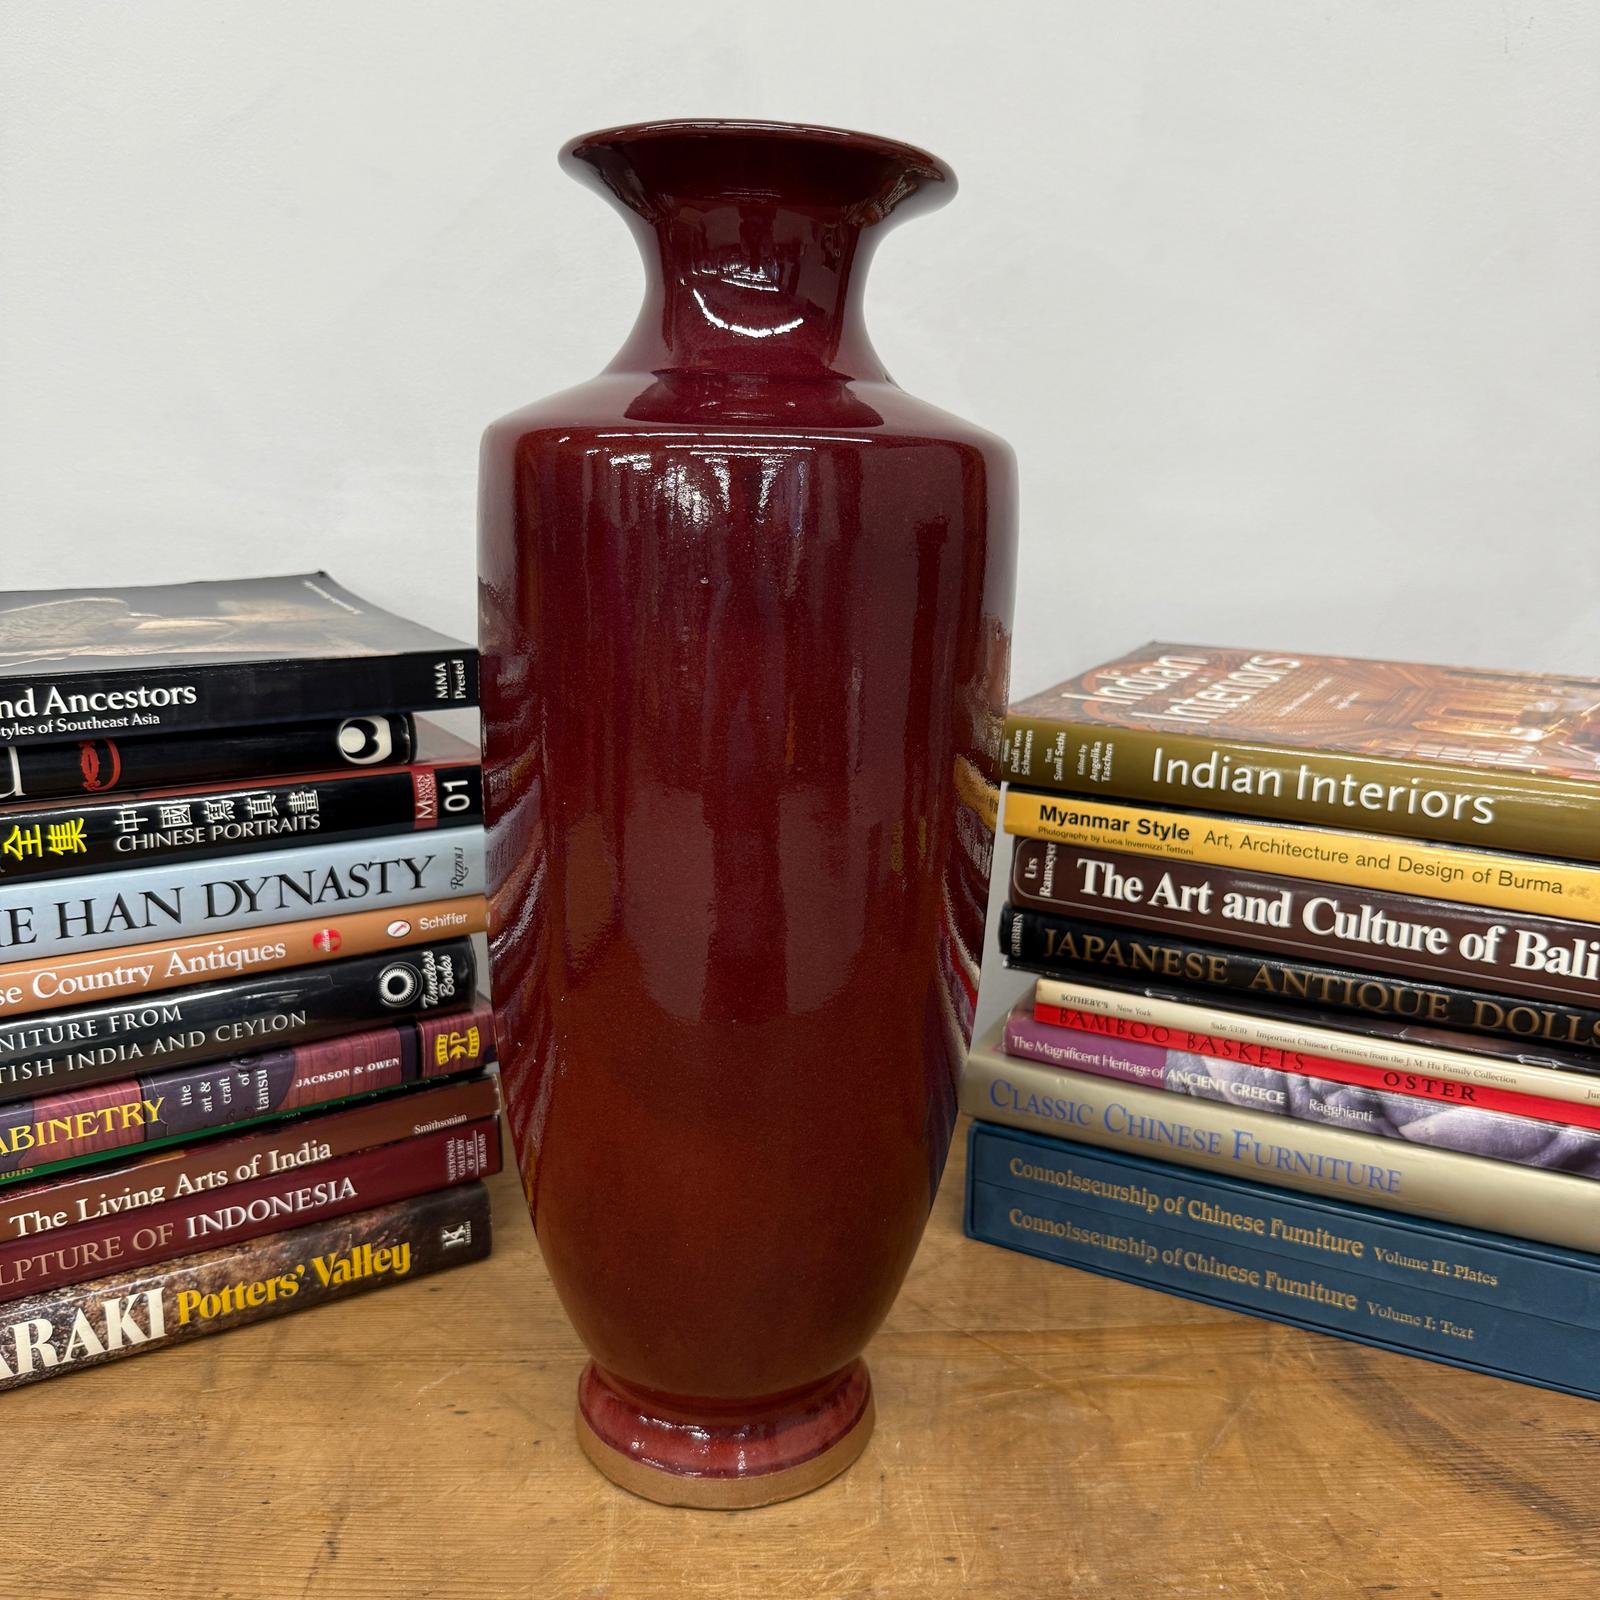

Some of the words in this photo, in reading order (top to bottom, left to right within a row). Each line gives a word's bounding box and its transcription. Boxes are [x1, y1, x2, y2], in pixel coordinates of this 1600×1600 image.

[434, 662, 448, 698] MMA
[452, 659, 466, 699] Prestel
[1061, 655, 1208, 705] Indian
[1131, 655, 1299, 724] Interiors
[0, 687, 38, 718] nd
[43, 686, 197, 715] Ancestors
[0, 722, 35, 740] tyles
[38, 719, 54, 734] of
[56, 716, 129, 732] Southeast
[132, 712, 160, 726] Asia
[1014, 729, 1022, 747] von
[1055, 732, 1066, 756] Sethi
[1011, 748, 1020, 773] Deidi
[1022, 729, 1033, 776] Schaewen
[1054, 757, 1063, 781] Sunil
[1089, 741, 1102, 782] Angelika
[1101, 743, 1114, 782] Taschen
[442, 780, 470, 812] 01
[1152, 747, 1280, 797] Indian
[1297, 764, 1496, 825] Interiors
[116, 826, 208, 852] CHINESE
[211, 814, 320, 841] PORTRAITS
[1038, 826, 1088, 841] Photography
[1090, 835, 1100, 843] by
[1102, 837, 1123, 846] Luca
[1125, 840, 1163, 851] Invernizzi
[1165, 844, 1194, 855] Tettoni
[1039, 805, 1130, 833] Myanmar
[1136, 818, 1190, 841] Style
[1204, 830, 1232, 850] Art,
[1239, 835, 1349, 864] Architecture
[1355, 854, 1390, 870] and
[1398, 856, 1464, 882] Design
[1472, 868, 1492, 884] of
[1498, 870, 1562, 894] Burma
[1024, 857, 1038, 879] Urs
[1039, 842, 1057, 897] Ramseyer
[0, 907, 37, 948] E
[54, 887, 184, 939] HAN
[201, 855, 436, 919] DYNASTY
[420, 912, 468, 931] Schiffer
[1077, 858, 1143, 902] The
[1147, 872, 1214, 915] Art
[1221, 890, 1293, 928] and
[1302, 897, 1449, 955] Culture
[1459, 925, 1506, 964] of
[1510, 929, 1600, 981] Bali
[32, 964, 153, 998] Country
[165, 942, 286, 978] Antiques
[421, 950, 438, 1009] Timeless
[437, 954, 455, 998] Books
[1043, 928, 1228, 984] JAPANESE
[1248, 964, 1450, 1021] ANTIQUE
[0, 1019, 98, 1053] NITURE
[109, 1005, 183, 1033] FROM
[0, 1057, 54, 1084] TISH
[67, 1043, 145, 1071] INDIA
[153, 1030, 206, 1054] AND
[215, 1010, 307, 1042] CEYLON
[1060, 993, 1109, 1009] SOTHEBY'S
[1116, 1003, 1133, 1013] New
[1135, 1007, 1152, 1017] York
[1256, 1030, 1295, 1045] Important
[1297, 1038, 1329, 1050] Chinese
[1330, 1044, 1368, 1058] Ceramics
[1369, 1050, 1388, 1062] from
[1390, 1055, 1403, 1065] the
[1427, 1062, 1441, 1072] Hu
[1443, 1064, 1473, 1078] Family
[1474, 1070, 1517, 1085] Collection
[1585, 1089, 1600, 1100] Ju
[295, 1068, 350, 1087] JACKSON
[353, 1066, 364, 1075] &
[367, 1057, 400, 1073] OWEN
[1058, 1008, 1170, 1043] BAMBOO
[1186, 1032, 1304, 1070] BASKETS
[1383, 1071, 1477, 1101] OSTER
[181, 1084, 193, 1106] the
[200, 1081, 211, 1092] &
[219, 1076, 232, 1105] craft
[238, 1072, 250, 1087] of
[256, 1069, 270, 1111] tansu
[1012, 1035, 1034, 1049] The
[1034, 1041, 1100, 1065] Magnificent
[1102, 1054, 1151, 1077] Heritage
[1151, 1066, 1165, 1078] of
[1167, 1069, 1227, 1092] ANCIENT
[1230, 1082, 1286, 1105] GREECE
[1309, 1098, 1374, 1122] Ragghianti
[201, 1097, 212, 1112] art
[414, 1113, 468, 1135] Smithsonian
[989, 1079, 1094, 1126] CLASSIC
[1104, 1103, 1222, 1155] CHINESE
[1232, 1129, 1402, 1194] FURNITURE
[9, 1211, 68, 1238] The
[76, 1186, 165, 1223] Living
[173, 1171, 229, 1198] Arts
[236, 1154, 262, 1181] of
[268, 1140, 332, 1173] India
[0, 1236, 124, 1287] LPTURE
[132, 1223, 174, 1250] OF
[185, 1176, 358, 1238] INDONESIA
[1009, 1157, 1159, 1212] Connoisseurship
[1163, 1196, 1187, 1215] of
[1187, 1199, 1265, 1235] Chinese
[1269, 1217, 1364, 1258] Furniture
[1374, 1246, 1429, 1271] Volume
[1431, 1259, 1450, 1276] II:
[1453, 1264, 1498, 1286] Plates
[311, 1242, 412, 1288] Valley
[1008, 1208, 1158, 1263] Connoisseurship
[1162, 1248, 1183, 1266] of
[1184, 1251, 1260, 1286] Chinese
[1264, 1270, 1358, 1310] Furniture
[1366, 1300, 1421, 1327] Volume
[1424, 1316, 1436, 1330] I:
[1440, 1319, 1475, 1340] Text
